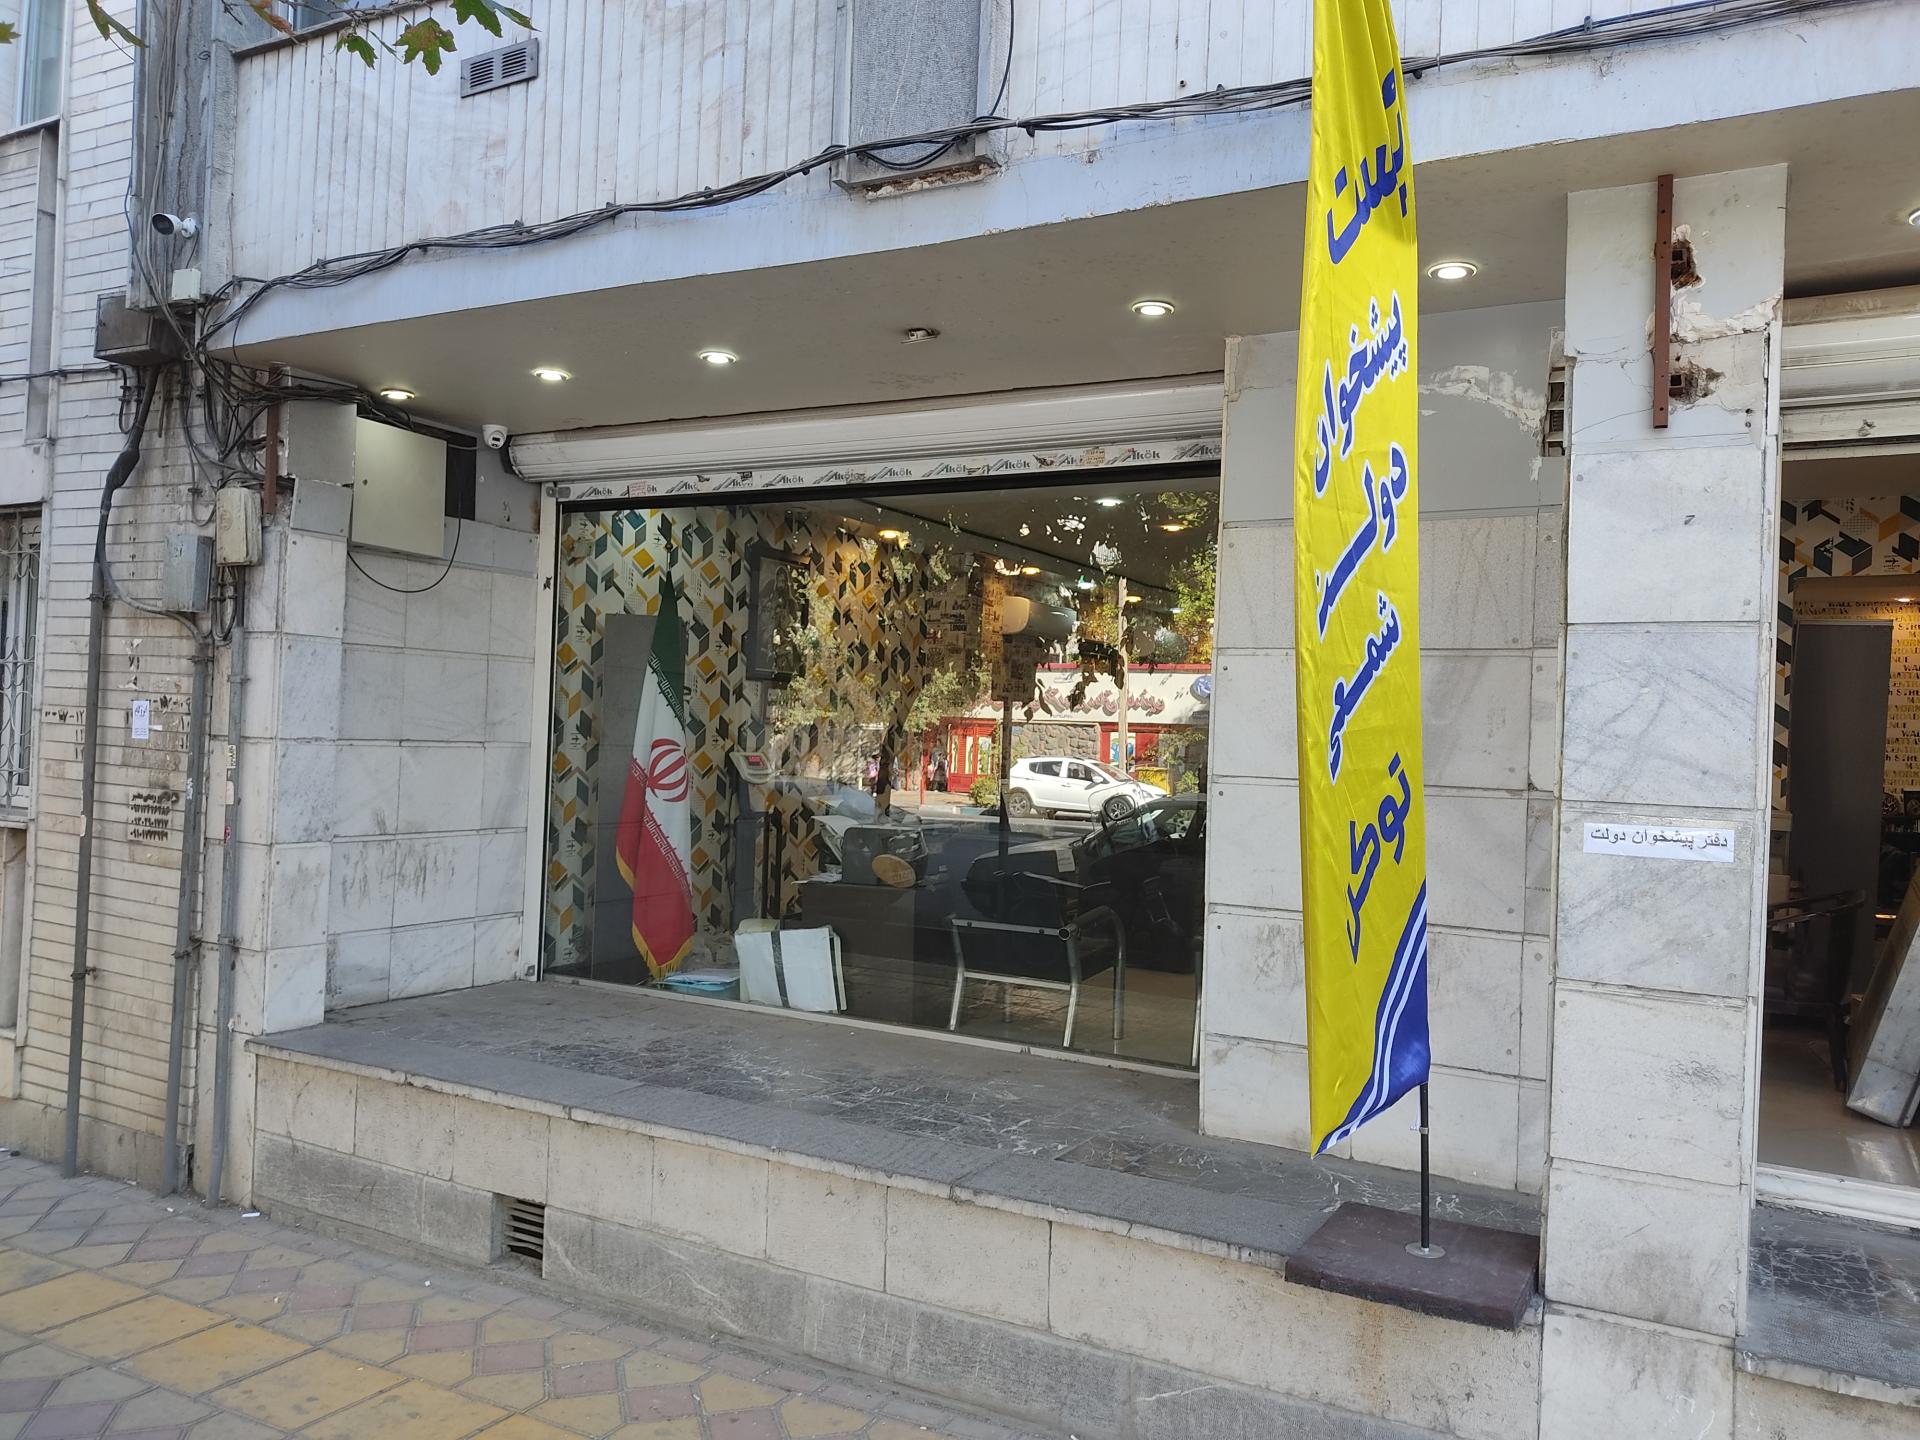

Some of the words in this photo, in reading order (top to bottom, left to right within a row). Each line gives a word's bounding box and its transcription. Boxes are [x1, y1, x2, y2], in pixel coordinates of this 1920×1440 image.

[1315, 290, 1408, 498] پیشخوان
[1590, 827, 1626, 844] دولت
[1631, 828, 1695, 850] پیشخوان
[1698, 831, 1728, 849] دفتر
